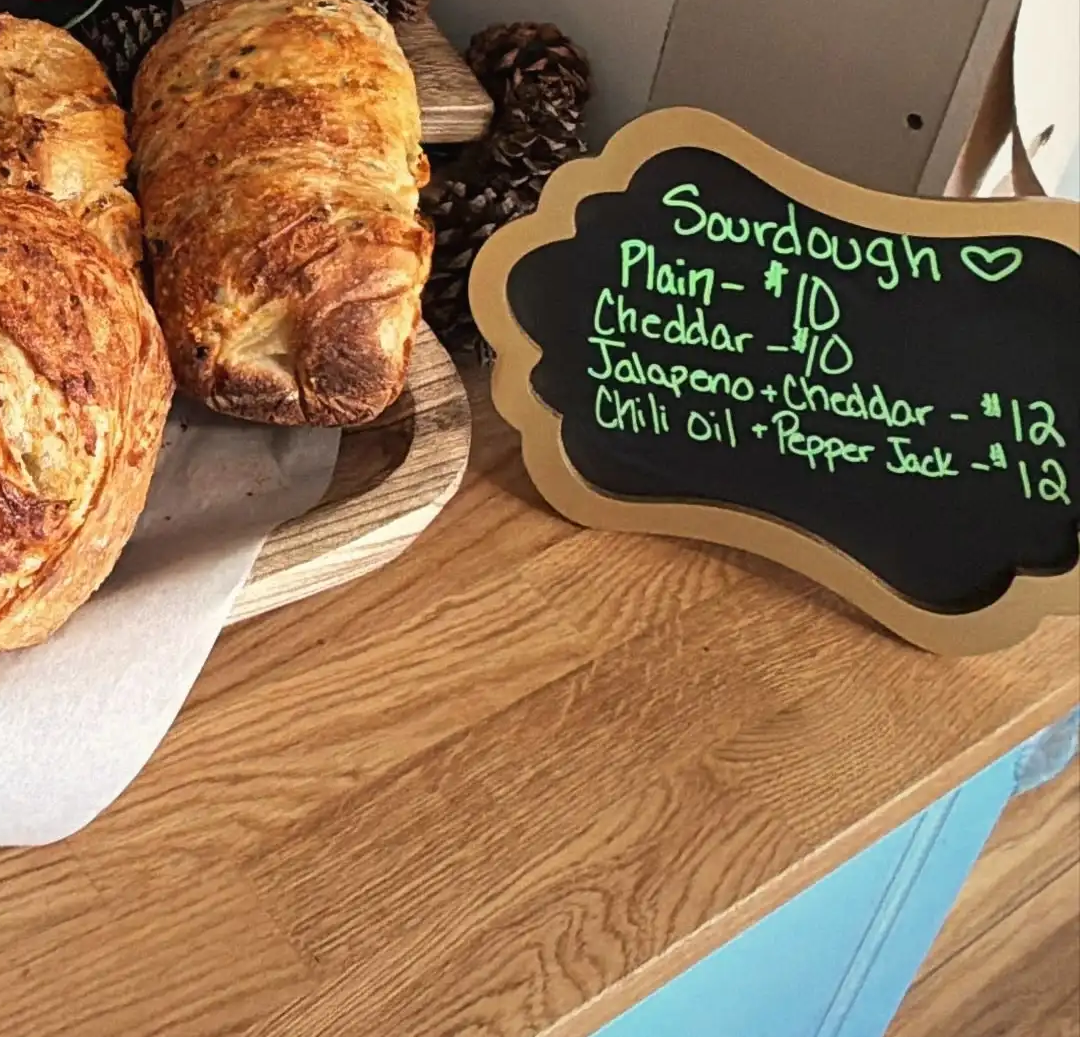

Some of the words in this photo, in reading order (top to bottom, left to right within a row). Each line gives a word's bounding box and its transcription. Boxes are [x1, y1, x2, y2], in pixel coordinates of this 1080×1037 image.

[662, 184, 941, 290] Sourdough
[594, 288, 754, 353] Cheddar
[588, 337, 754, 398] Jalapeno
[783, 373, 935, 427] Cheddar
[595, 384, 669, 434] Chili
[772, 410, 875, 473] Pepper
[886, 436, 959, 477] Jack
